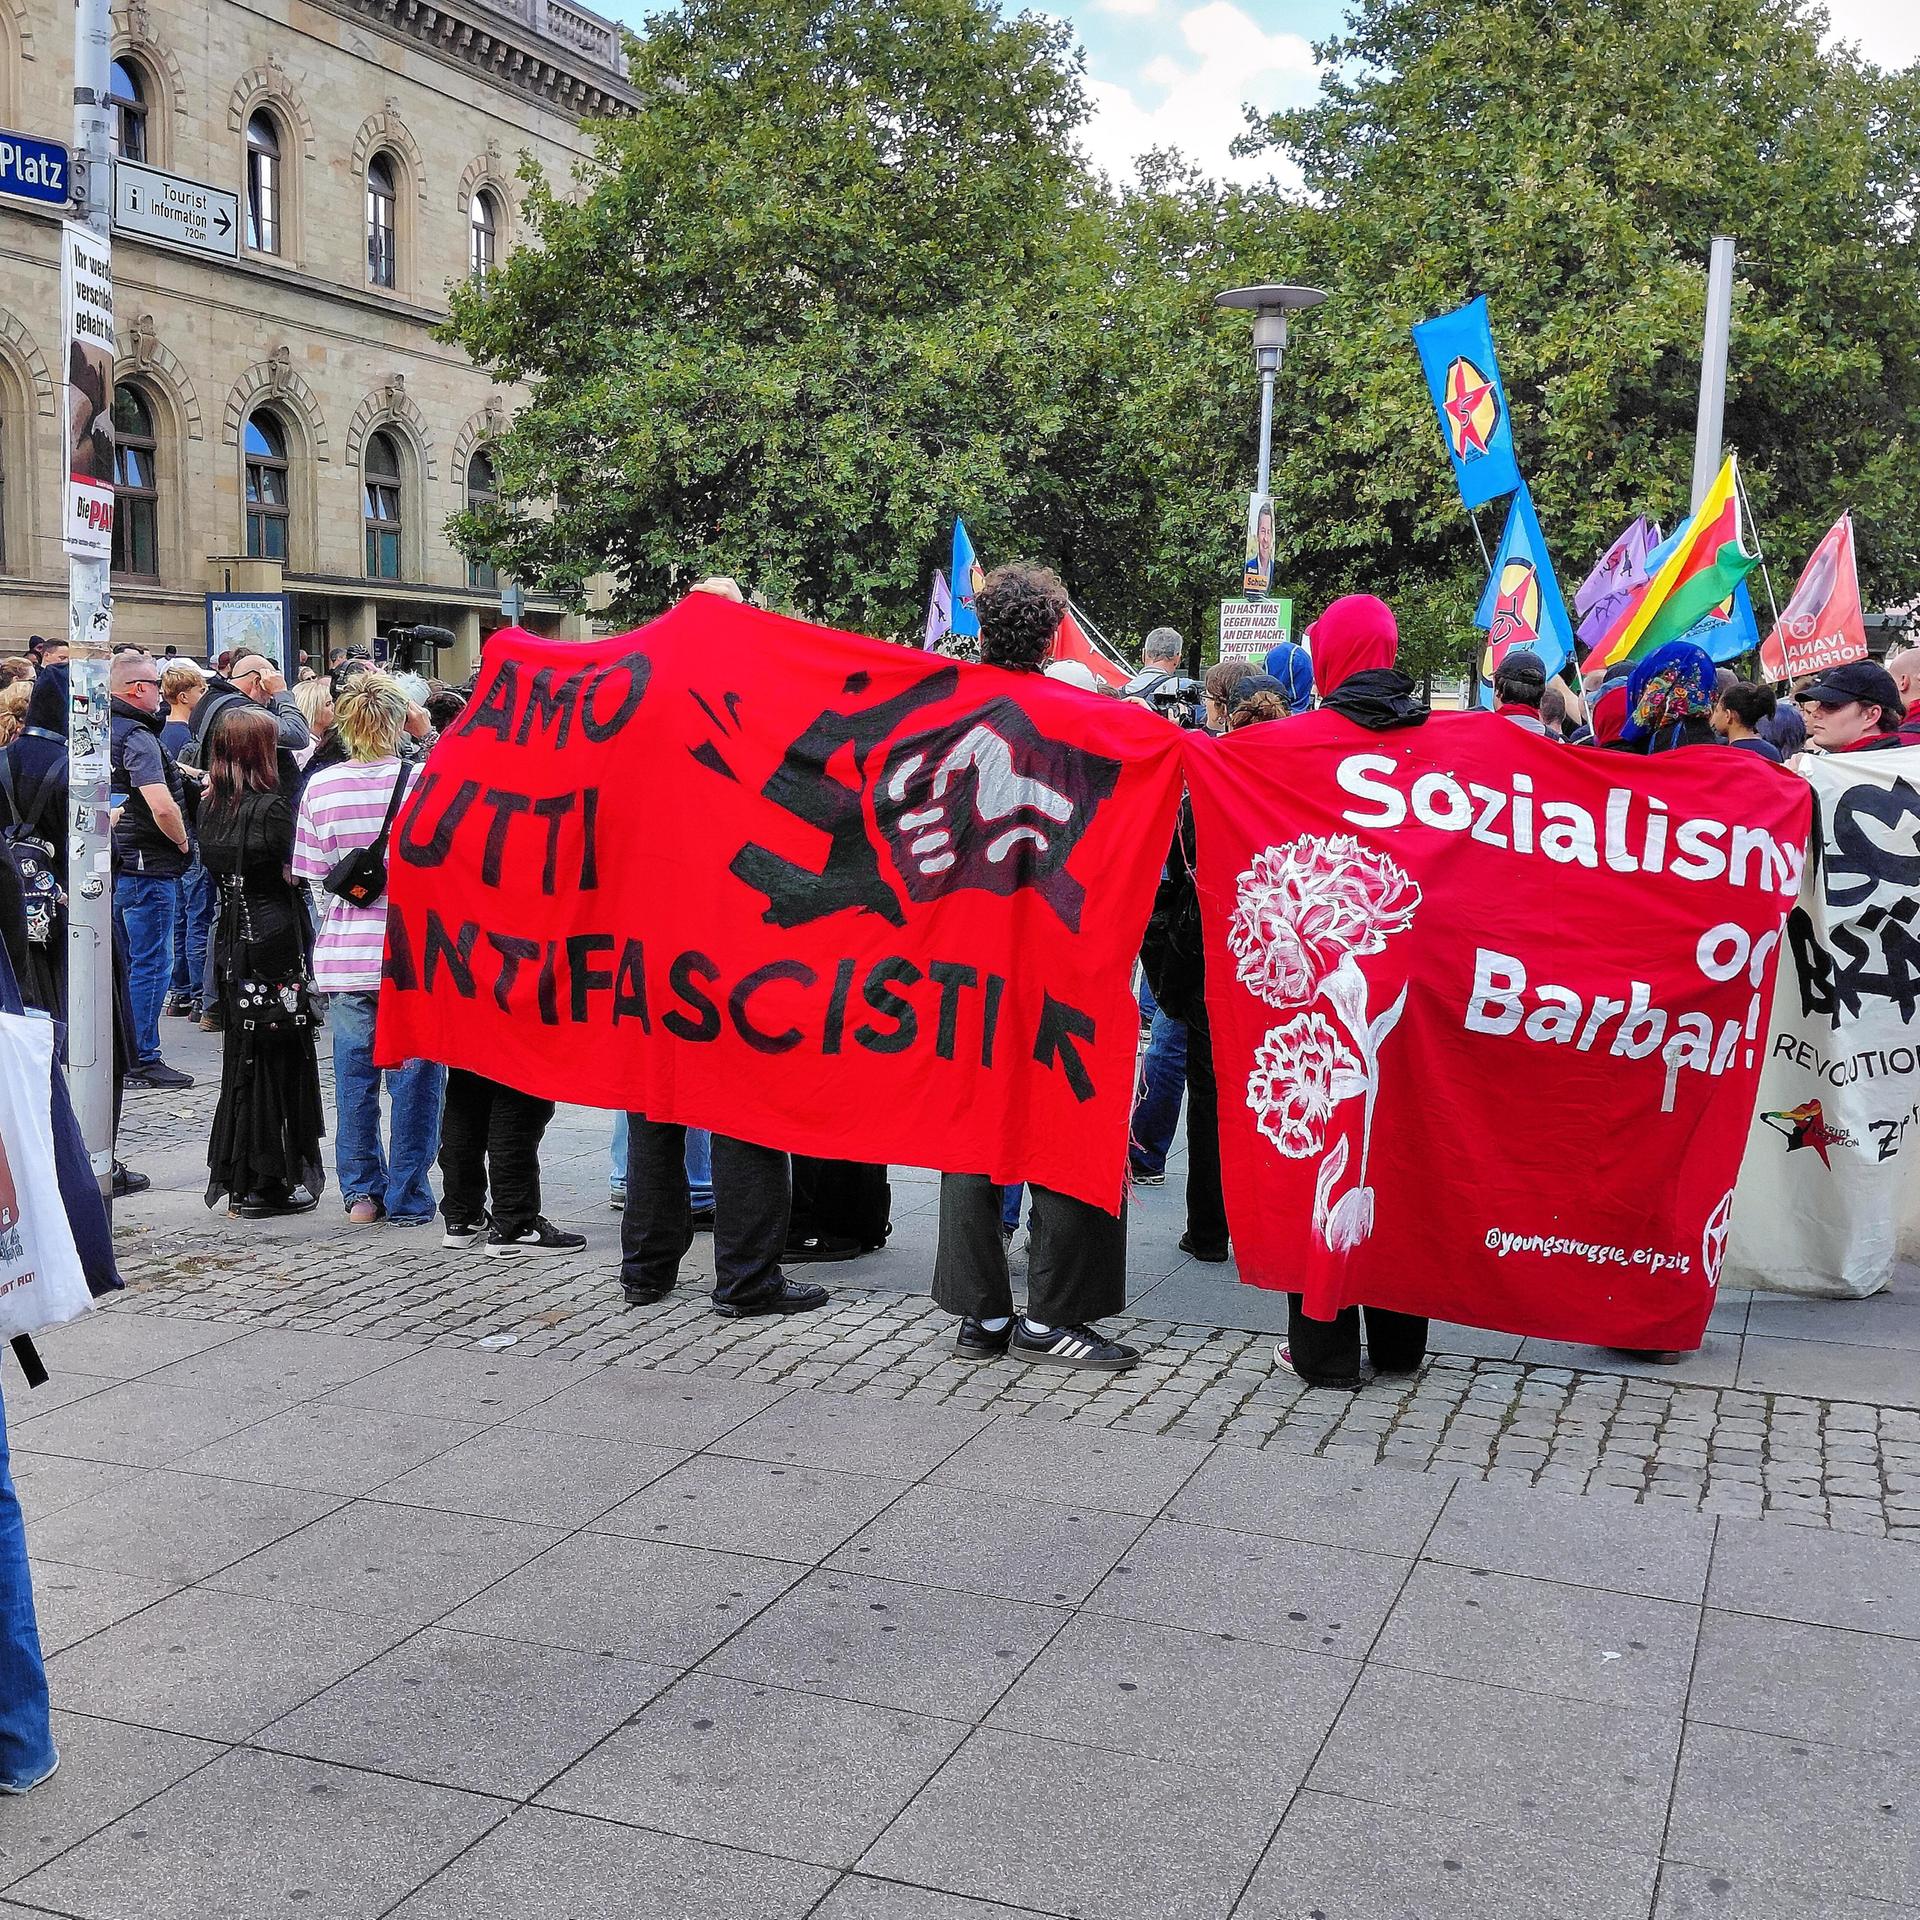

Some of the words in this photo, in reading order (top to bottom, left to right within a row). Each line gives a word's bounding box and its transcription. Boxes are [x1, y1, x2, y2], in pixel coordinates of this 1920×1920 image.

[0, 141, 62, 189] Platz
[162, 182, 207, 210] Tourist
[151, 198, 207, 229] Information
[185, 227, 207, 241] 720m
[74, 244, 87, 270] Ihr
[76, 310, 104, 339] gehabt
[1223, 604, 1236, 615] DU
[1236, 604, 1260, 615] HAST
[1260, 604, 1279, 615] WAS
[1223, 617, 1252, 627] GEGEN
[1251, 617, 1277, 627] NAZIS
[1223, 630, 1236, 640] AN
[1235, 630, 1254, 640] DER
[1253, 630, 1285, 640] MACHT:
[1223, 642, 1280, 653] ZWEITSTIMM
[399, 772, 599, 896] UTTI
